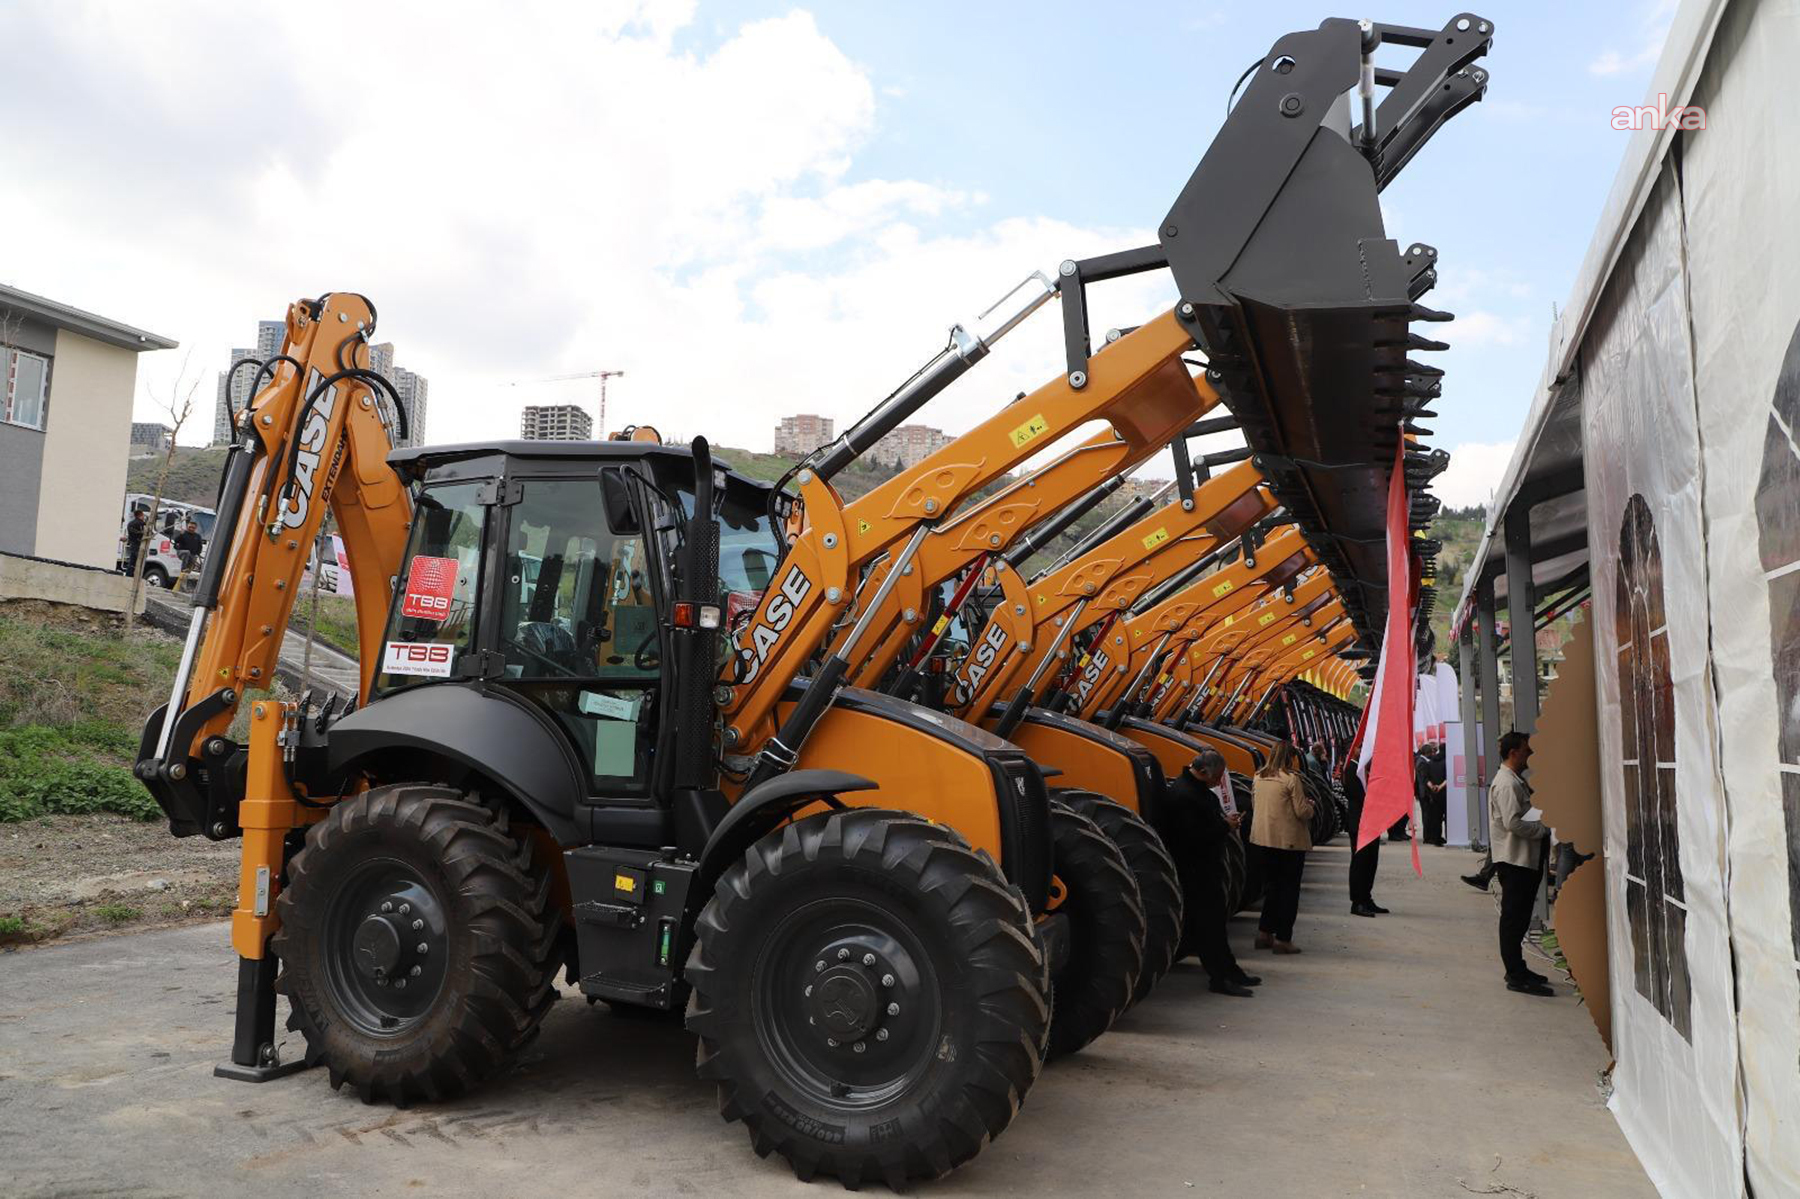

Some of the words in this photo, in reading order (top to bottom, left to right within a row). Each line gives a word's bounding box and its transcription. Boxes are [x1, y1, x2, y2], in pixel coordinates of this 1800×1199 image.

[278, 366, 338, 529] CASE
[409, 594, 448, 609] TBB
[733, 563, 812, 684] CASE
[390, 644, 449, 663] TBB
[955, 621, 1008, 704] CASE
